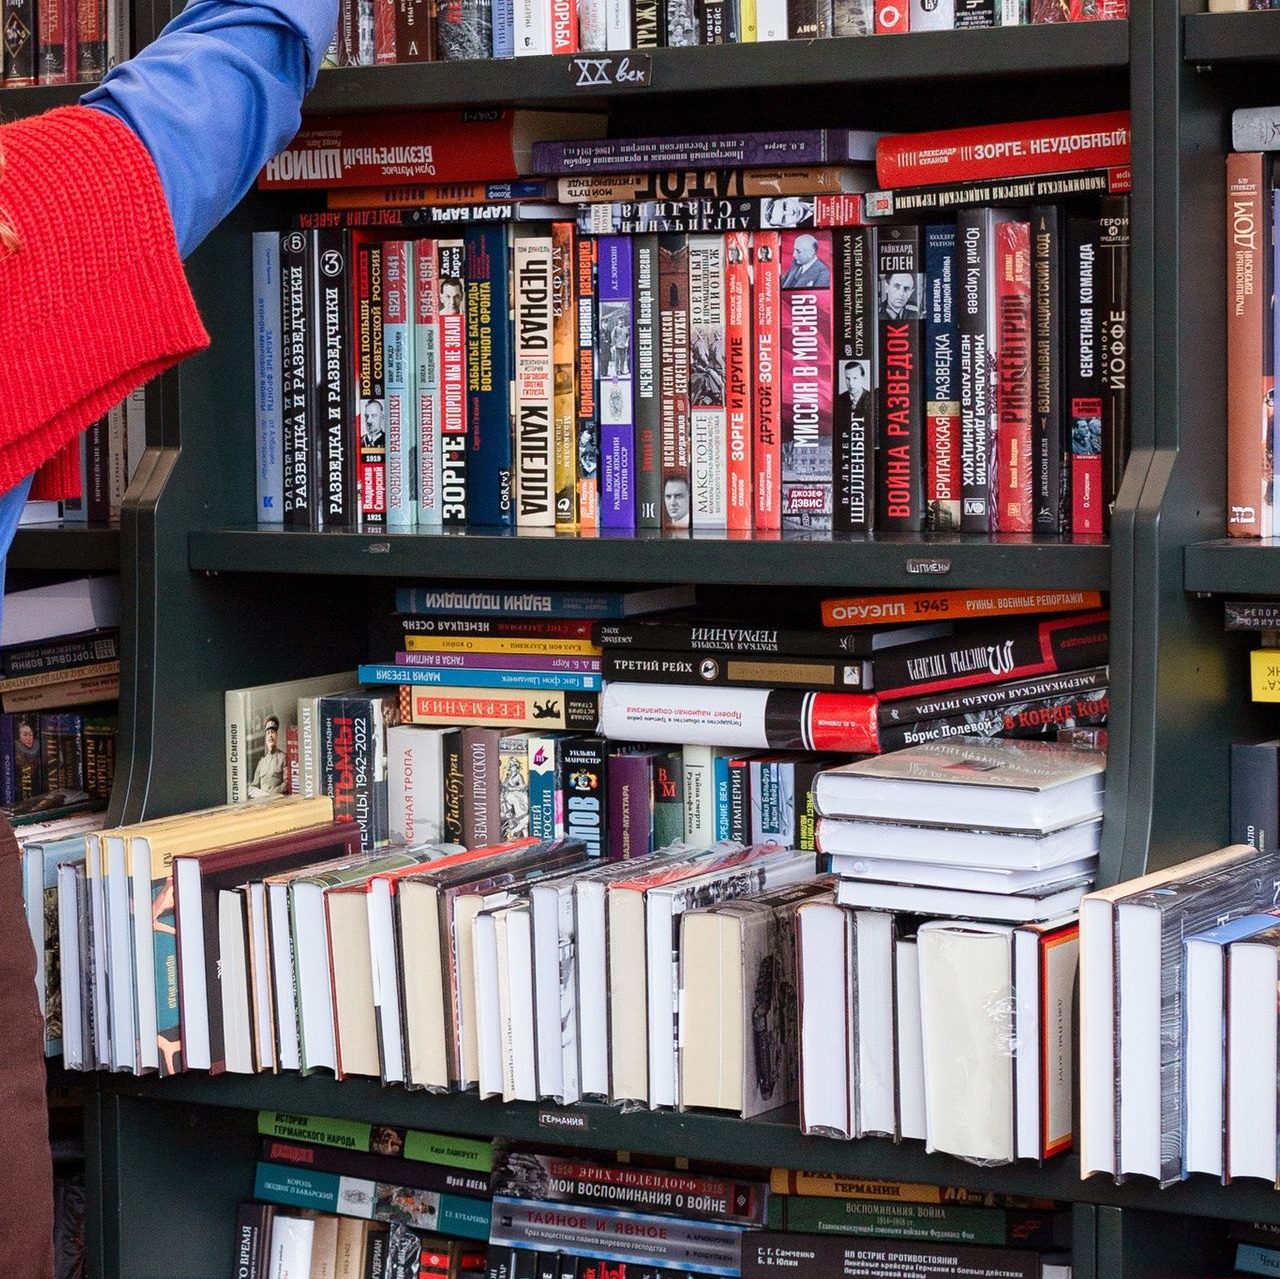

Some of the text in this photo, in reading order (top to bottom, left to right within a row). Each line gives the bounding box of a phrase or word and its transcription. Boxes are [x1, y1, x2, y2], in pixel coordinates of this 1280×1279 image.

[615, 57, 645, 82] век
[266, 149, 342, 177] ШПИОН
[343, 145, 433, 163] БЕЗУПРЕЧНЫЙ
[974, 131, 1125, 161] ЗОРГЕ. НЕУДОБНЫЙ
[432, 206, 511, 221] КАРЛ БАРЦ
[1233, 200, 1256, 249] ДОМ
[881, 254, 913, 271] ГЕЛЕН
[468, 282, 479, 391] ЗАБЫТЫЕ БАСТАРДЫ
[480, 282, 491, 392] ВОСТОЧНОГО ФРОНТА
[1110, 309, 1125, 389] ИОФФЕ
[519, 260, 548, 516] ЧЕРНАЯ КАПЕЛЛА
[792, 293, 819, 450] МИССИЯ В МОСКВУ
[325, 287, 343, 514] РАЗВЕДКА И РАЗВЕДЧИКИ
[886, 324, 913, 519] ВОЙНА РАЗВЕДОК
[442, 437, 465, 519] ЗОРГЕ
[851, 412, 864, 522] ШЕЛЛЕНБЕРГ
[425, 595, 551, 612] БУДНИ ПОДЛОДКИ
[832, 592, 1083, 619] ОРУЭЛЛ 1945 РУИНЫ. ВОЕННЫЕ РЕПОРТАЖИ
[905, 721, 992, 744] Борис Полевой
[541, 1115, 583, 1126] ГЕРМАНИЯ
